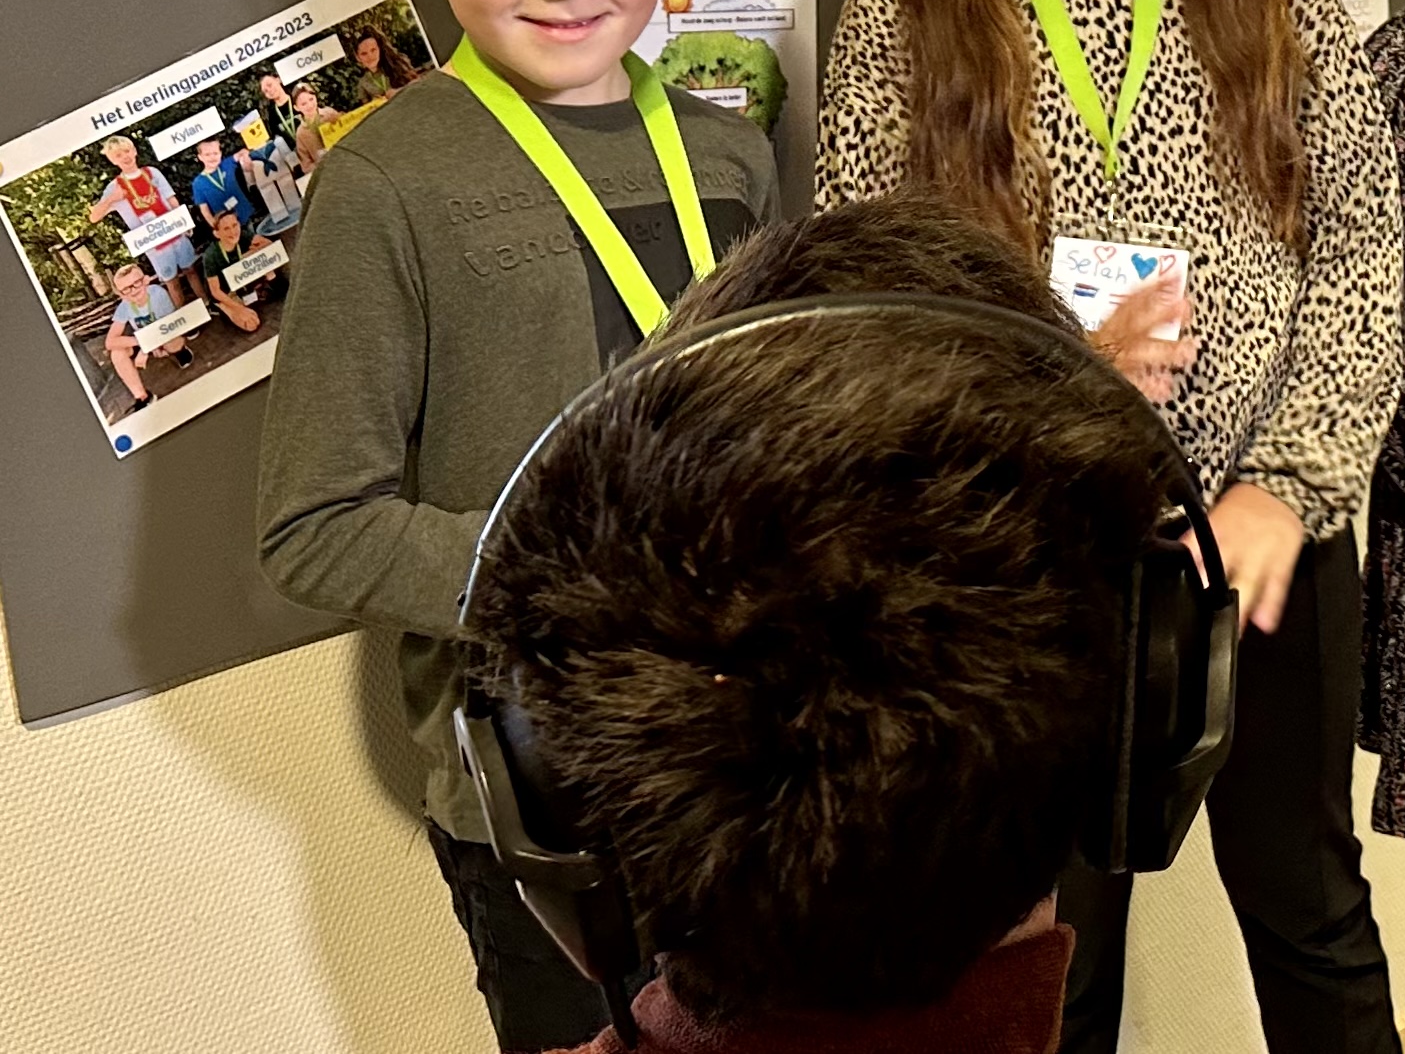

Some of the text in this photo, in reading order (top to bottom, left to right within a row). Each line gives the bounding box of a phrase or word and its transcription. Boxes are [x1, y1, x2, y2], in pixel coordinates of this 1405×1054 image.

[91, 11, 315, 132] Het leerlingpanel 2022-2023
[295, 47, 325, 70] Cody
[169, 120, 204, 146] Kylan
[133, 217, 187, 249] (secretaris)
[146, 218, 168, 233] Don
[234, 252, 281, 284] (voorzitter)
[241, 252, 267, 269] Bram
[1067, 249, 1128, 284] Selah
[159, 315, 187, 335] Sem
